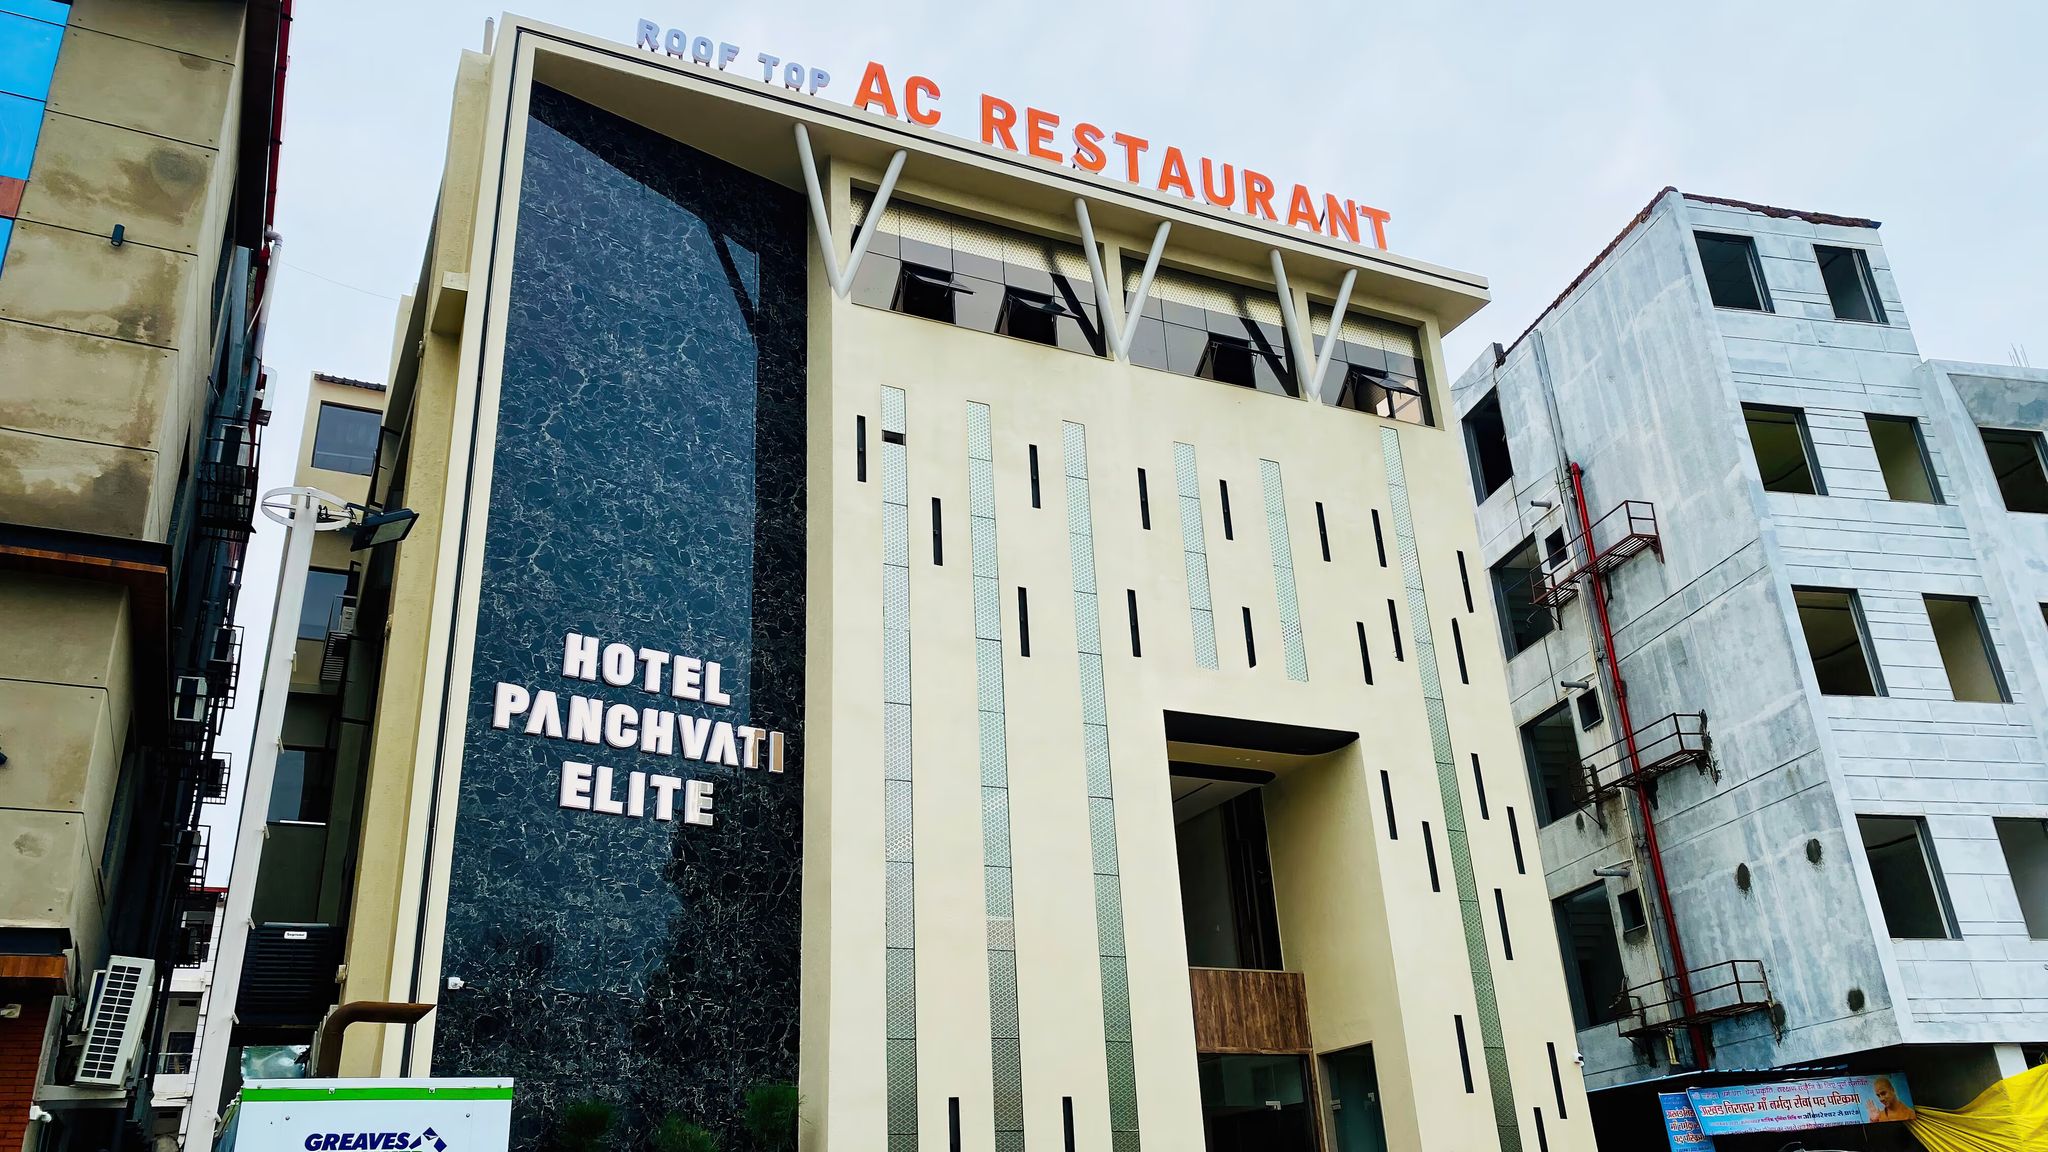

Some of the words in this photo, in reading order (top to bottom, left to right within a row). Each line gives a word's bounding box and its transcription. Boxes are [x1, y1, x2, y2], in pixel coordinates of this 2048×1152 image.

[637, 18, 740, 69] ROOF
[758, 52, 831, 94] TOP
[852, 61, 942, 128] AC
[979, 93, 1392, 251] RESTAURANT
[562, 632, 731, 706] HOTEL
[492, 682, 785, 773] PANCHVATI
[560, 761, 714, 826] ELITE
[304, 1132, 411, 1151] GREAVES
